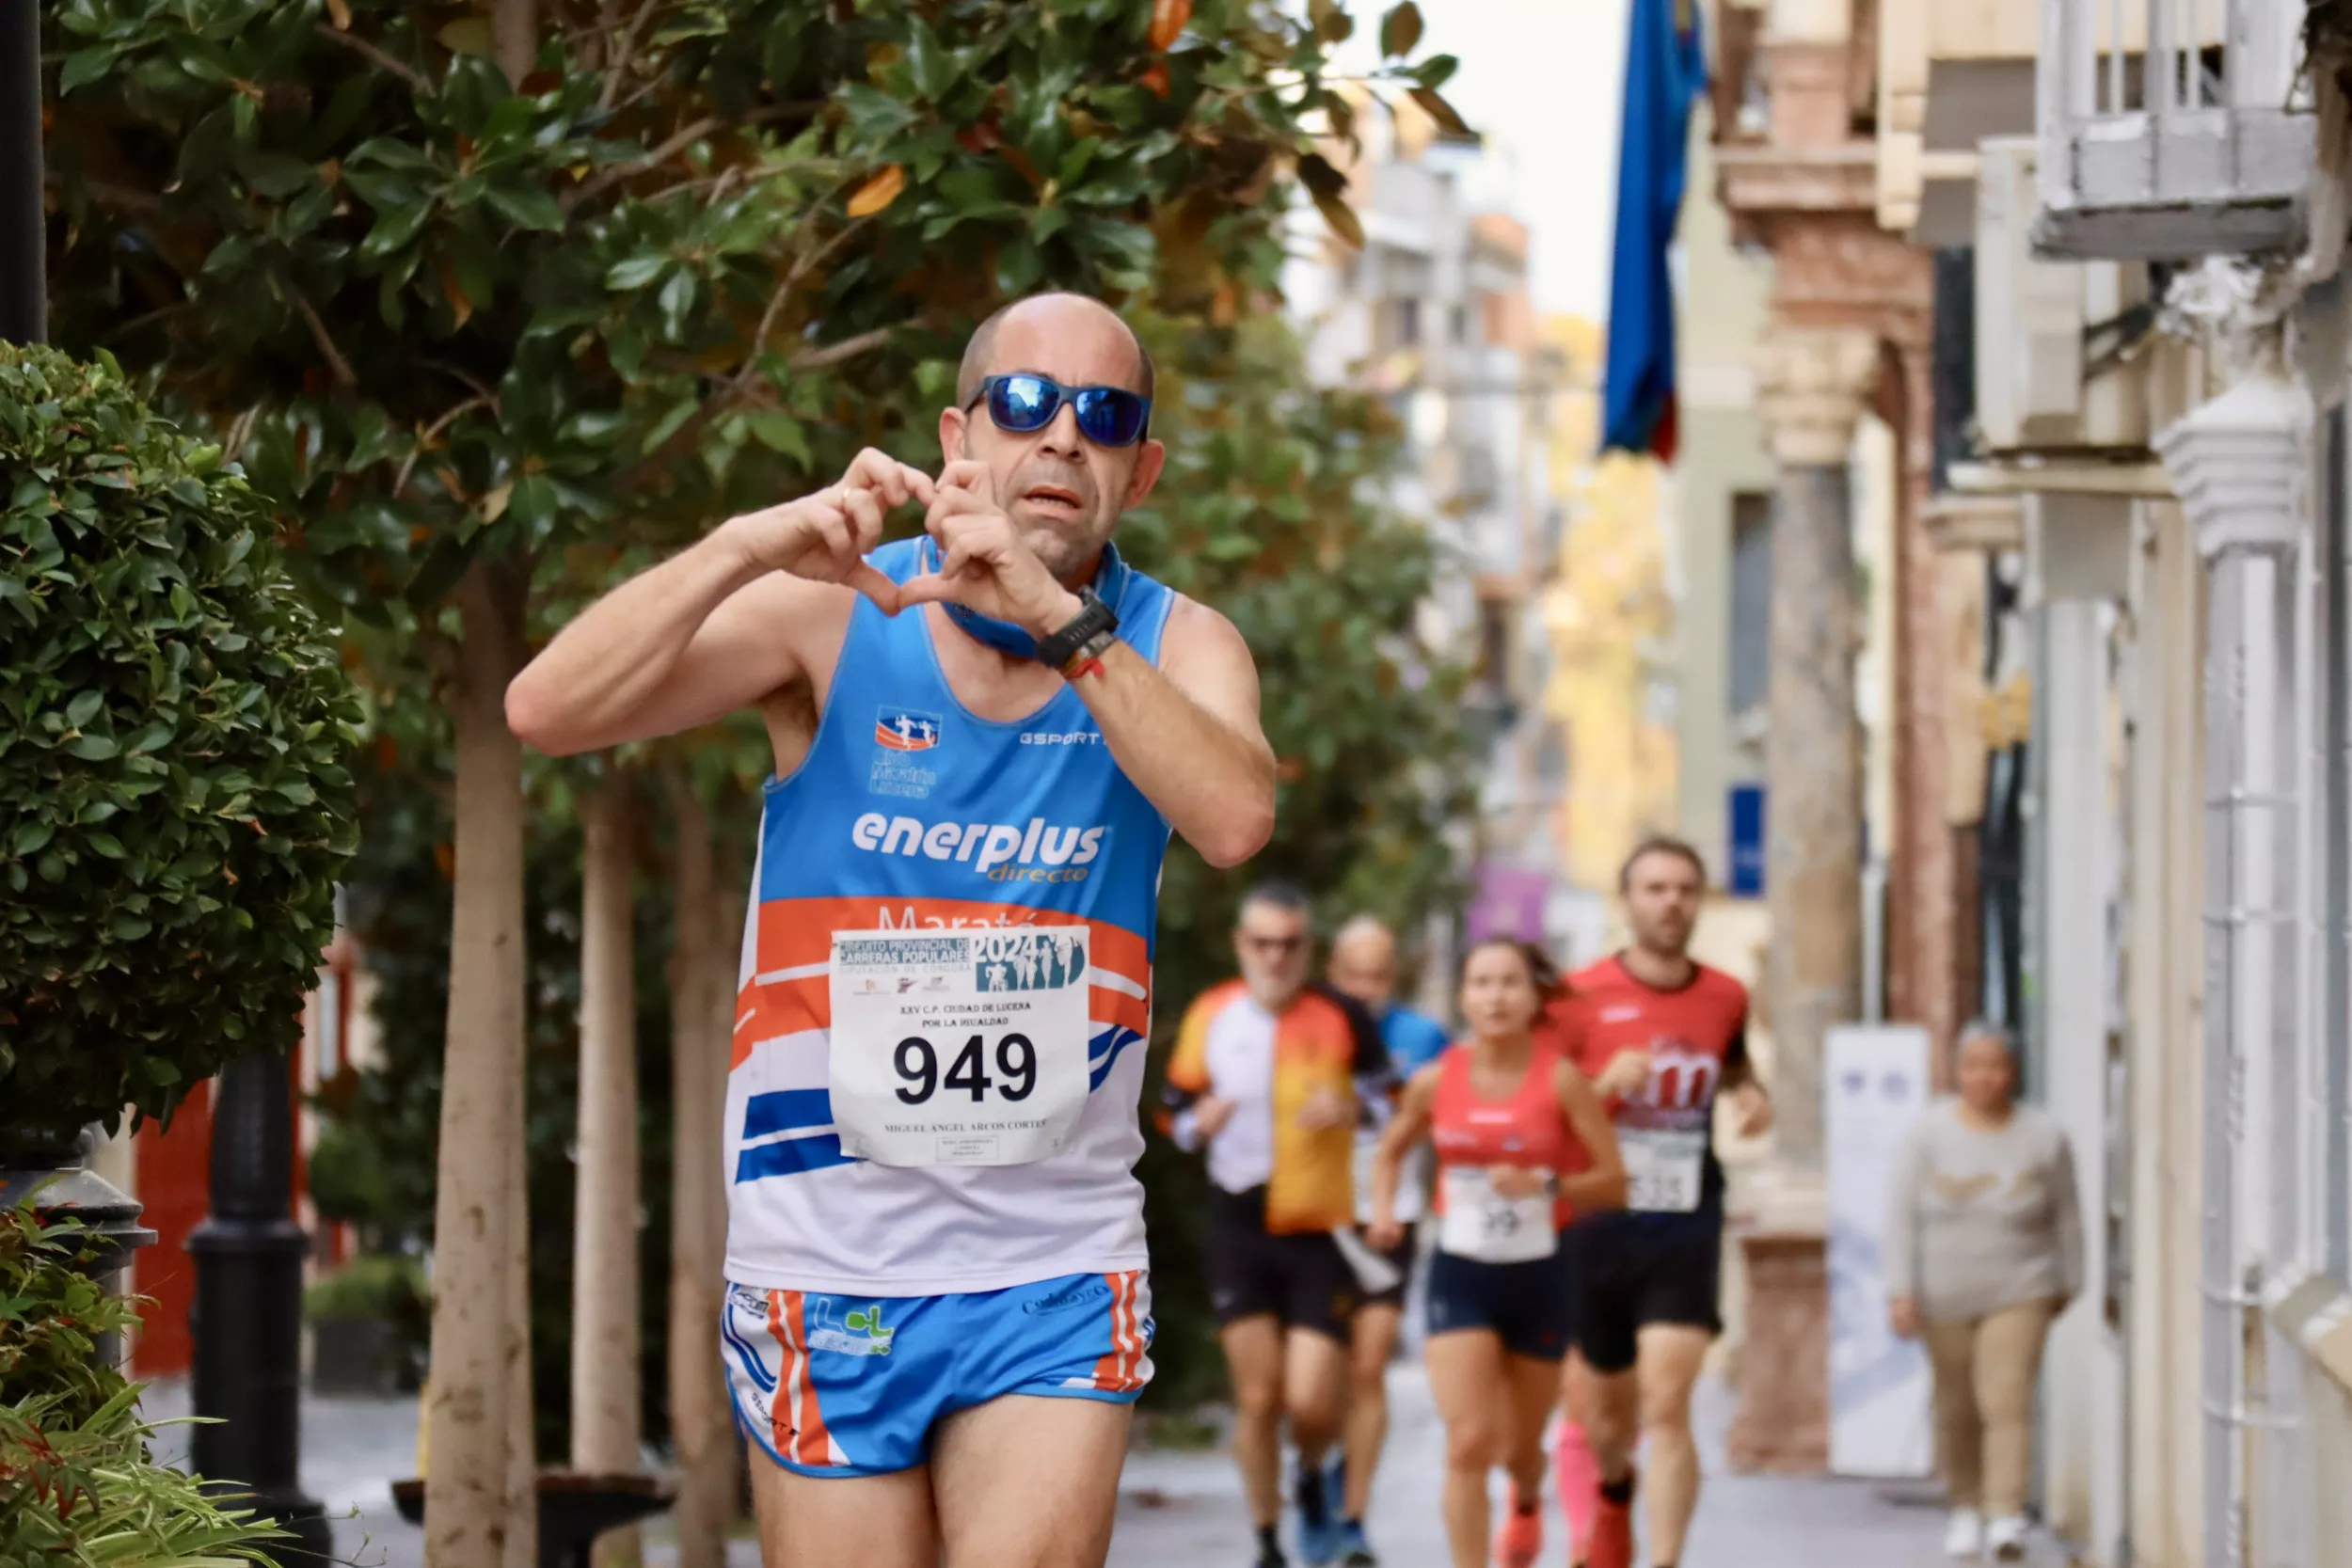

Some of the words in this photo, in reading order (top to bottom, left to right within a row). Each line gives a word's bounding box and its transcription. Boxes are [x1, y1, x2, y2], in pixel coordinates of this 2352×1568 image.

[851, 812, 1105, 874] enerplus
[988, 863, 1089, 883] directo
[889, 939, 952, 952] PROVINCIAL
[973, 935, 1040, 963] 2024
[840, 952, 899, 964] CARRERAS
[902, 949, 971, 962] POPULARES
[944, 1004, 979, 1013] CIUDAD
[982, 1003, 994, 1012] DE
[997, 1002, 1031, 1011] LUCENA
[922, 1019, 940, 1028] POR
[945, 1019, 957, 1027] LA
[893, 1032, 1037, 1105] 949
[884, 1124, 927, 1133] MIGUEL
[970, 1122, 1005, 1132] ARCOS
